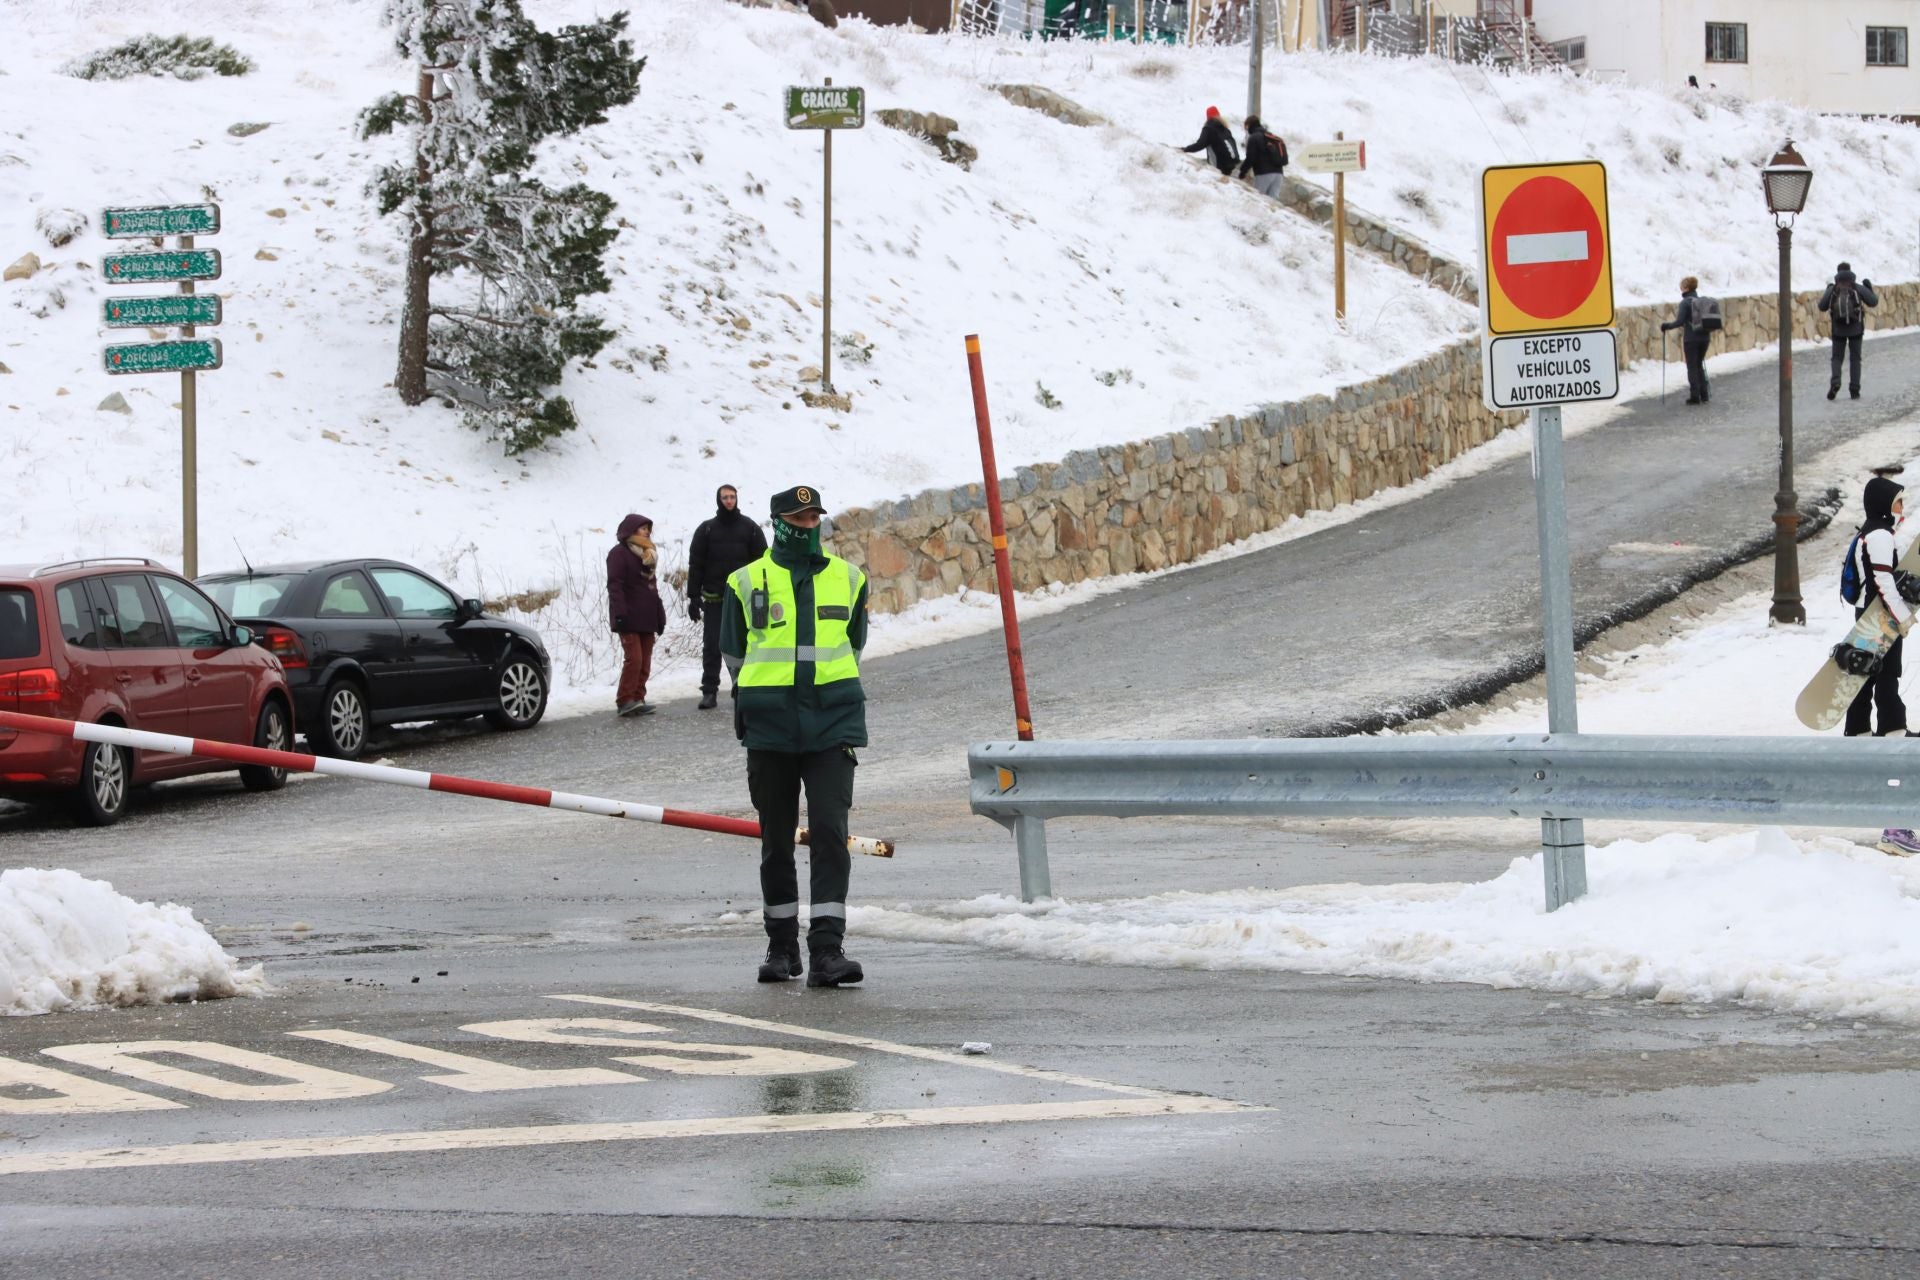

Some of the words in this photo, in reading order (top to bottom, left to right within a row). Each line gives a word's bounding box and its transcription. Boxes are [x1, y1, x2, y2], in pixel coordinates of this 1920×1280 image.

[801, 91, 849, 109] GRACIAS
[1524, 337, 1582, 356] EXCEPTO
[125, 351, 169, 364] OFICINAS
[1517, 358, 1592, 379] VEHÍCULOS
[1510, 380, 1602, 402] AUTORIZADOS
[794, 530, 809, 540] LA
